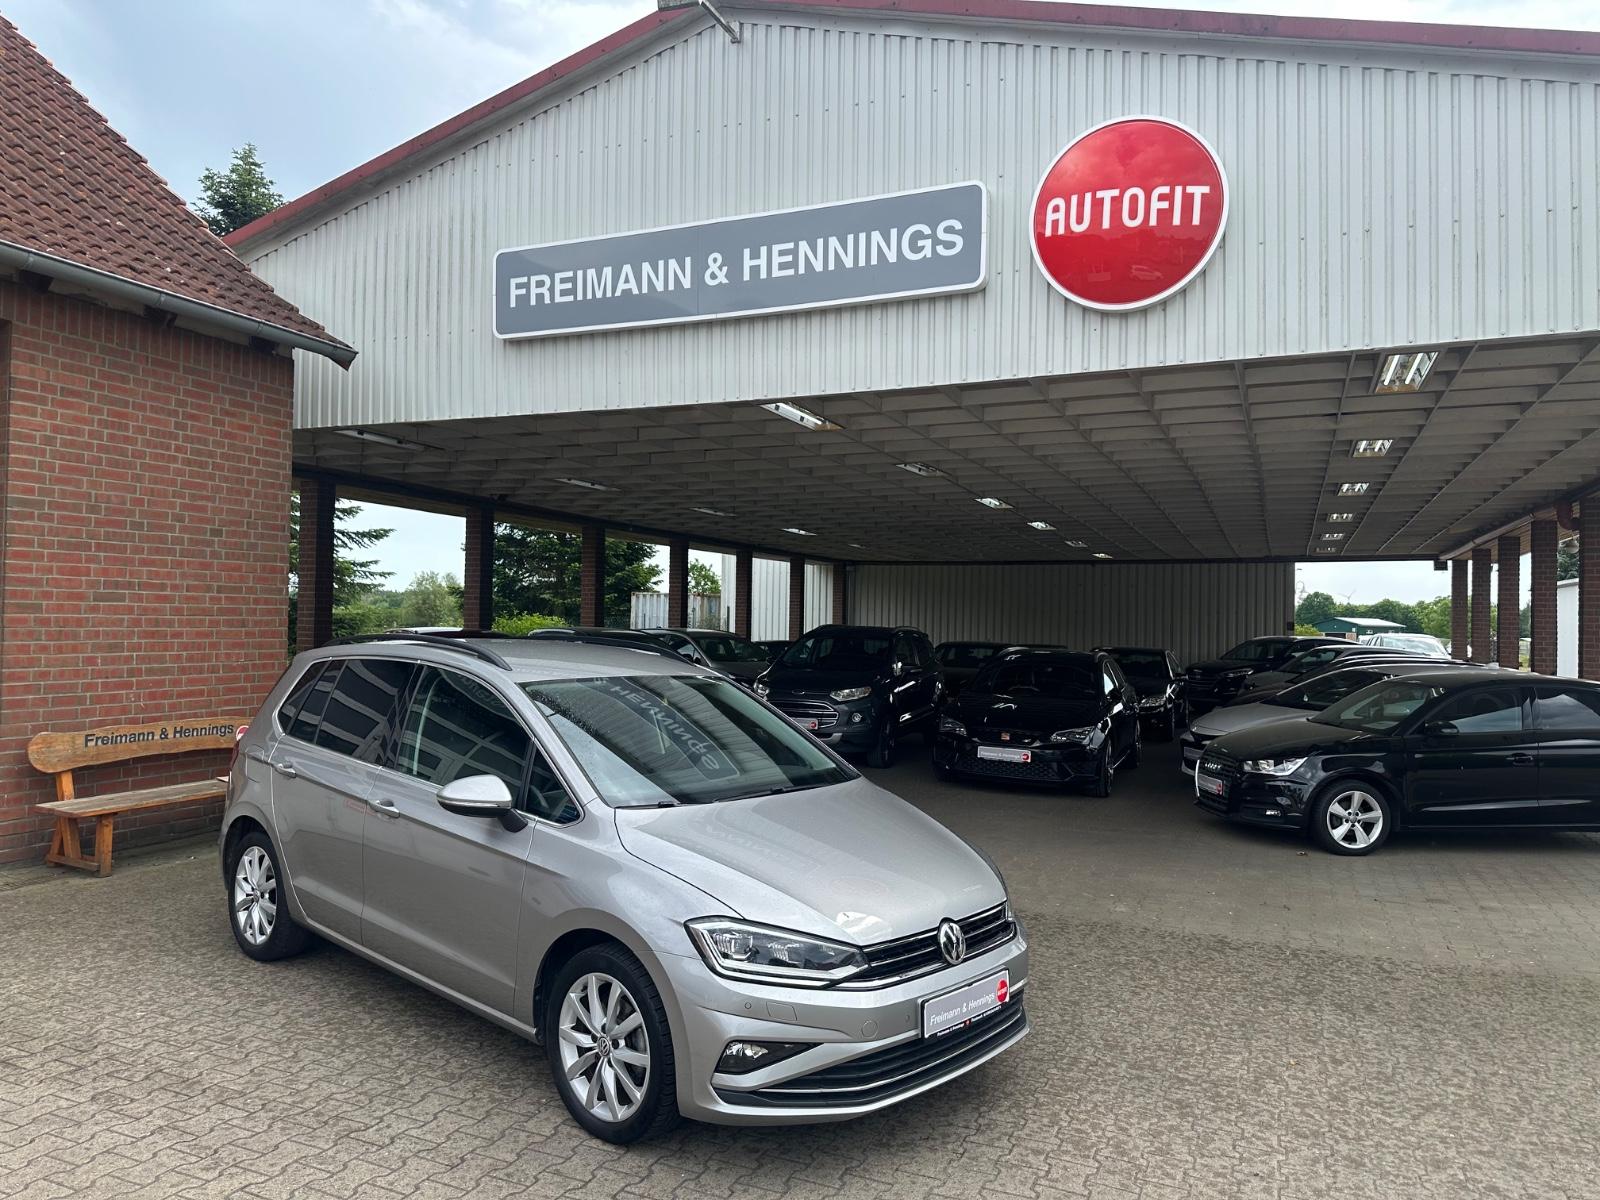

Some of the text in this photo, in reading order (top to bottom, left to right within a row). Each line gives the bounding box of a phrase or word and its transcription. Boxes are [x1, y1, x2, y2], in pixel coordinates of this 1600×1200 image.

[1044, 185, 1211, 237] AUTOFIT
[508, 218, 964, 308] FREIMANN & HENNINGS
[84, 724, 234, 748] Freimann & Hennings
[930, 1007, 961, 1026] Freimann
